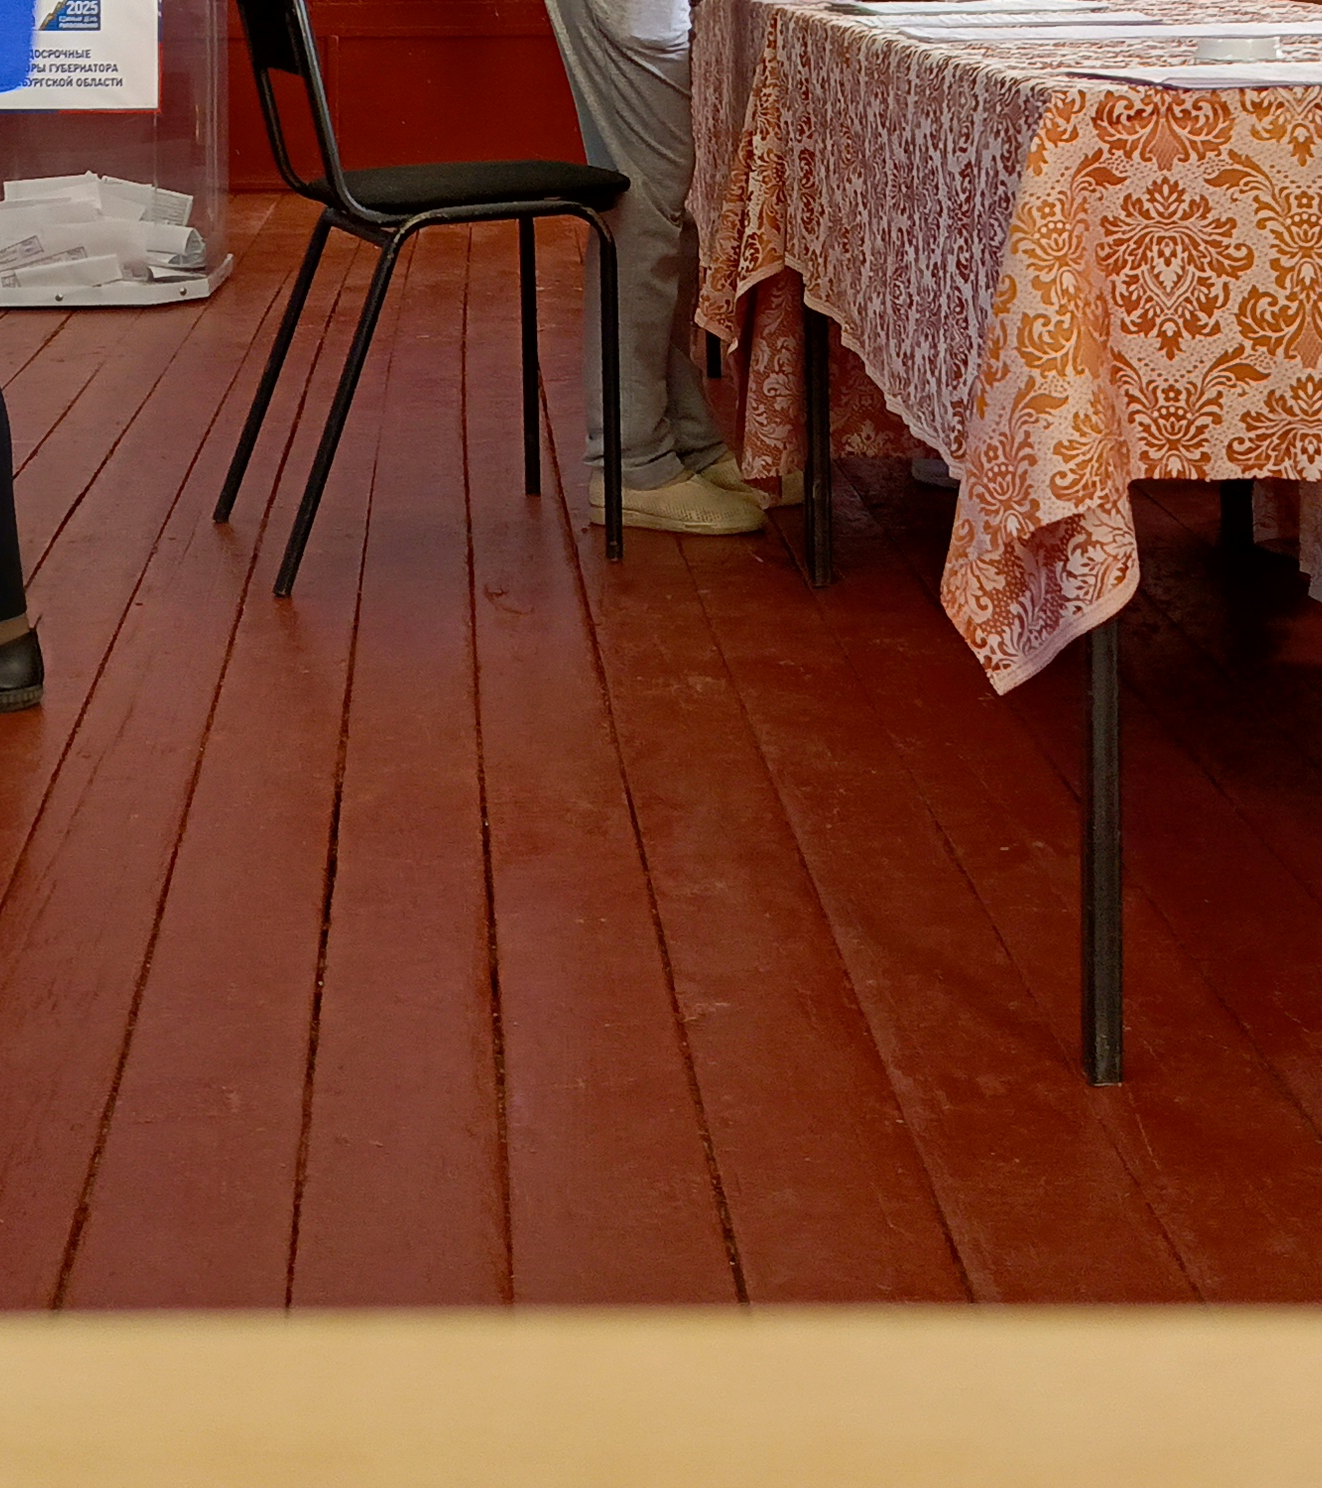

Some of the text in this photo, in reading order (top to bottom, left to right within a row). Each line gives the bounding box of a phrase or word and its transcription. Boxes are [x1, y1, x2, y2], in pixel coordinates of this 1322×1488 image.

[66, 0, 99, 15] 2025
[49, 63, 118, 73] ГУБЕРНАТОРА
[76, 77, 123, 87] ОБЛАСТИ
